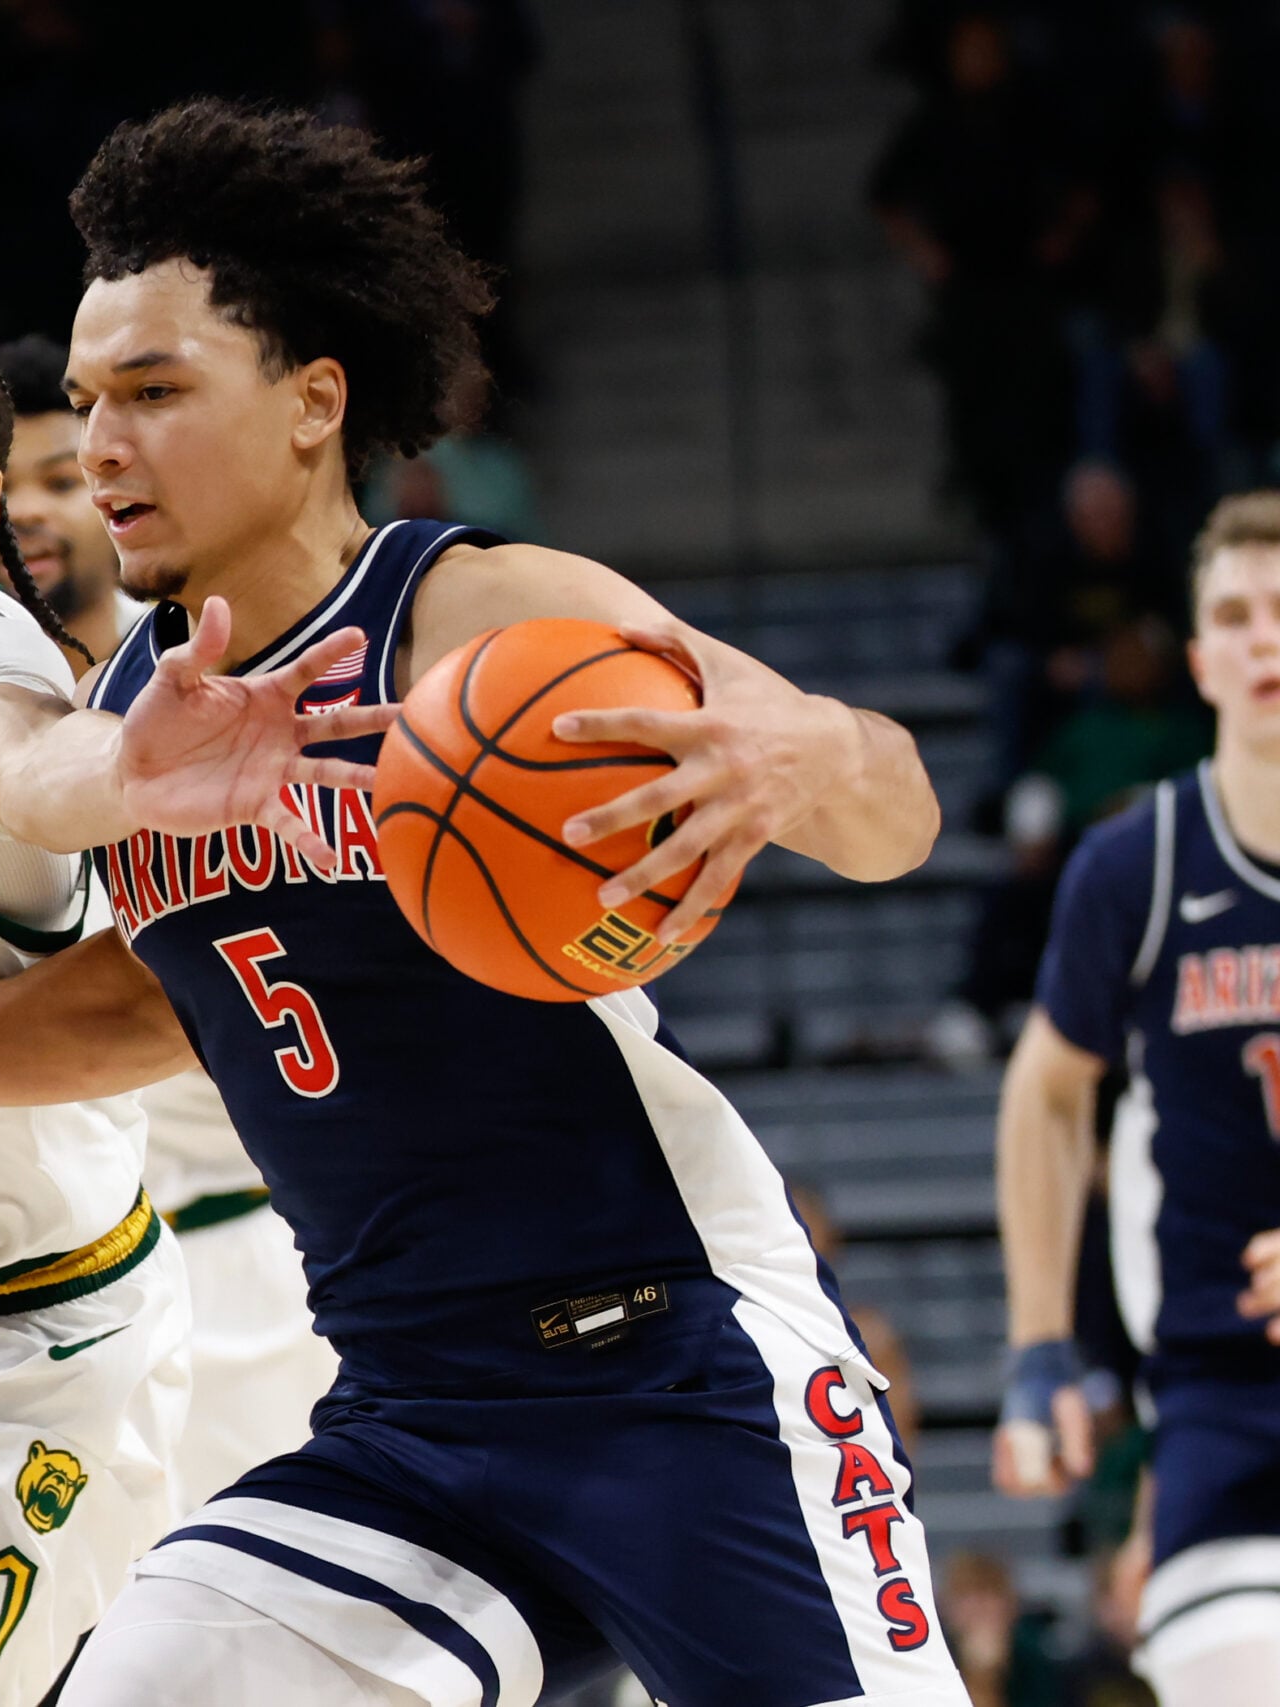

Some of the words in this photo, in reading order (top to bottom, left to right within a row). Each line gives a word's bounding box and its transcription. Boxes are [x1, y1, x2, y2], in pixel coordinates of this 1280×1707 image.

[211, 926, 341, 1100] 5
[633, 1286, 657, 1304] 46
[804, 1365, 929, 1652] CATS
